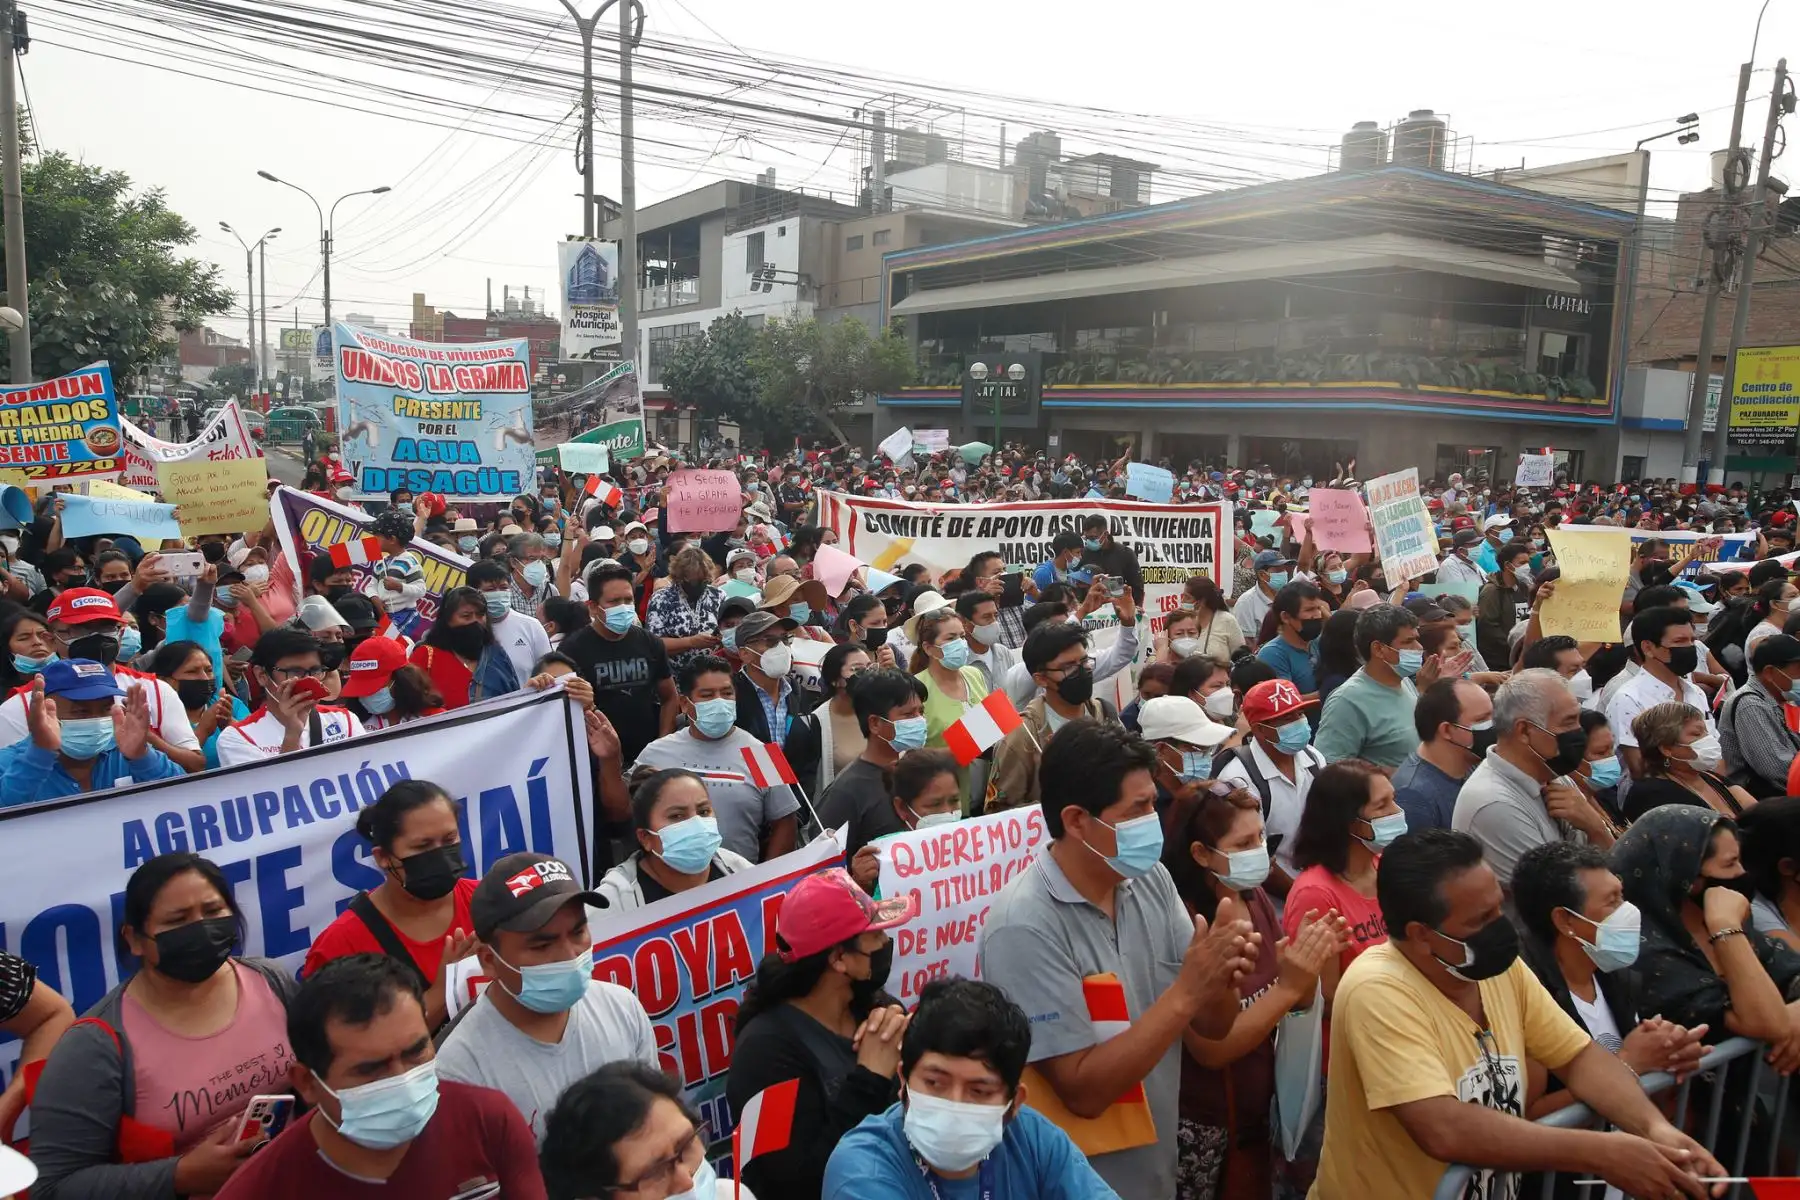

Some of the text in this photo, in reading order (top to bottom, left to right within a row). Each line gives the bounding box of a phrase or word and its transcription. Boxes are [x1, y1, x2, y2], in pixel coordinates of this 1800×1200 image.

[570, 319, 617, 332] Municipal
[575, 310, 611, 321] Hospital
[357, 333, 515, 361] ASOCIACIÓN DE VIVIENDAS
[341, 348, 528, 391] UNIDOS LA GRAMA
[1733, 394, 1800, 405] Conciliación
[1742, 382, 1792, 393] Centro de
[393, 396, 482, 420] PRESENTE
[21, 424, 85, 443] PIEDRA
[418, 423, 457, 435] POR EL
[391, 437, 482, 465] AGUA
[56, 459, 116, 475] 720
[352, 461, 522, 494] Y DESAGÜE
[863, 512, 944, 538] COMITÉ
[947, 517, 976, 538] DE
[976, 515, 1044, 538] APOYO
[1110, 515, 1133, 537] DE
[1132, 517, 1213, 538] VIVIENDA
[1164, 543, 1213, 563] PIEDRA
[595, 657, 649, 684] PUMA
[123, 760, 412, 869] AGRUPACIÓN
[890, 809, 1044, 878] QUEREMOS
[897, 927, 928, 957] DE
[208, 1053, 267, 1086] THE BEST
